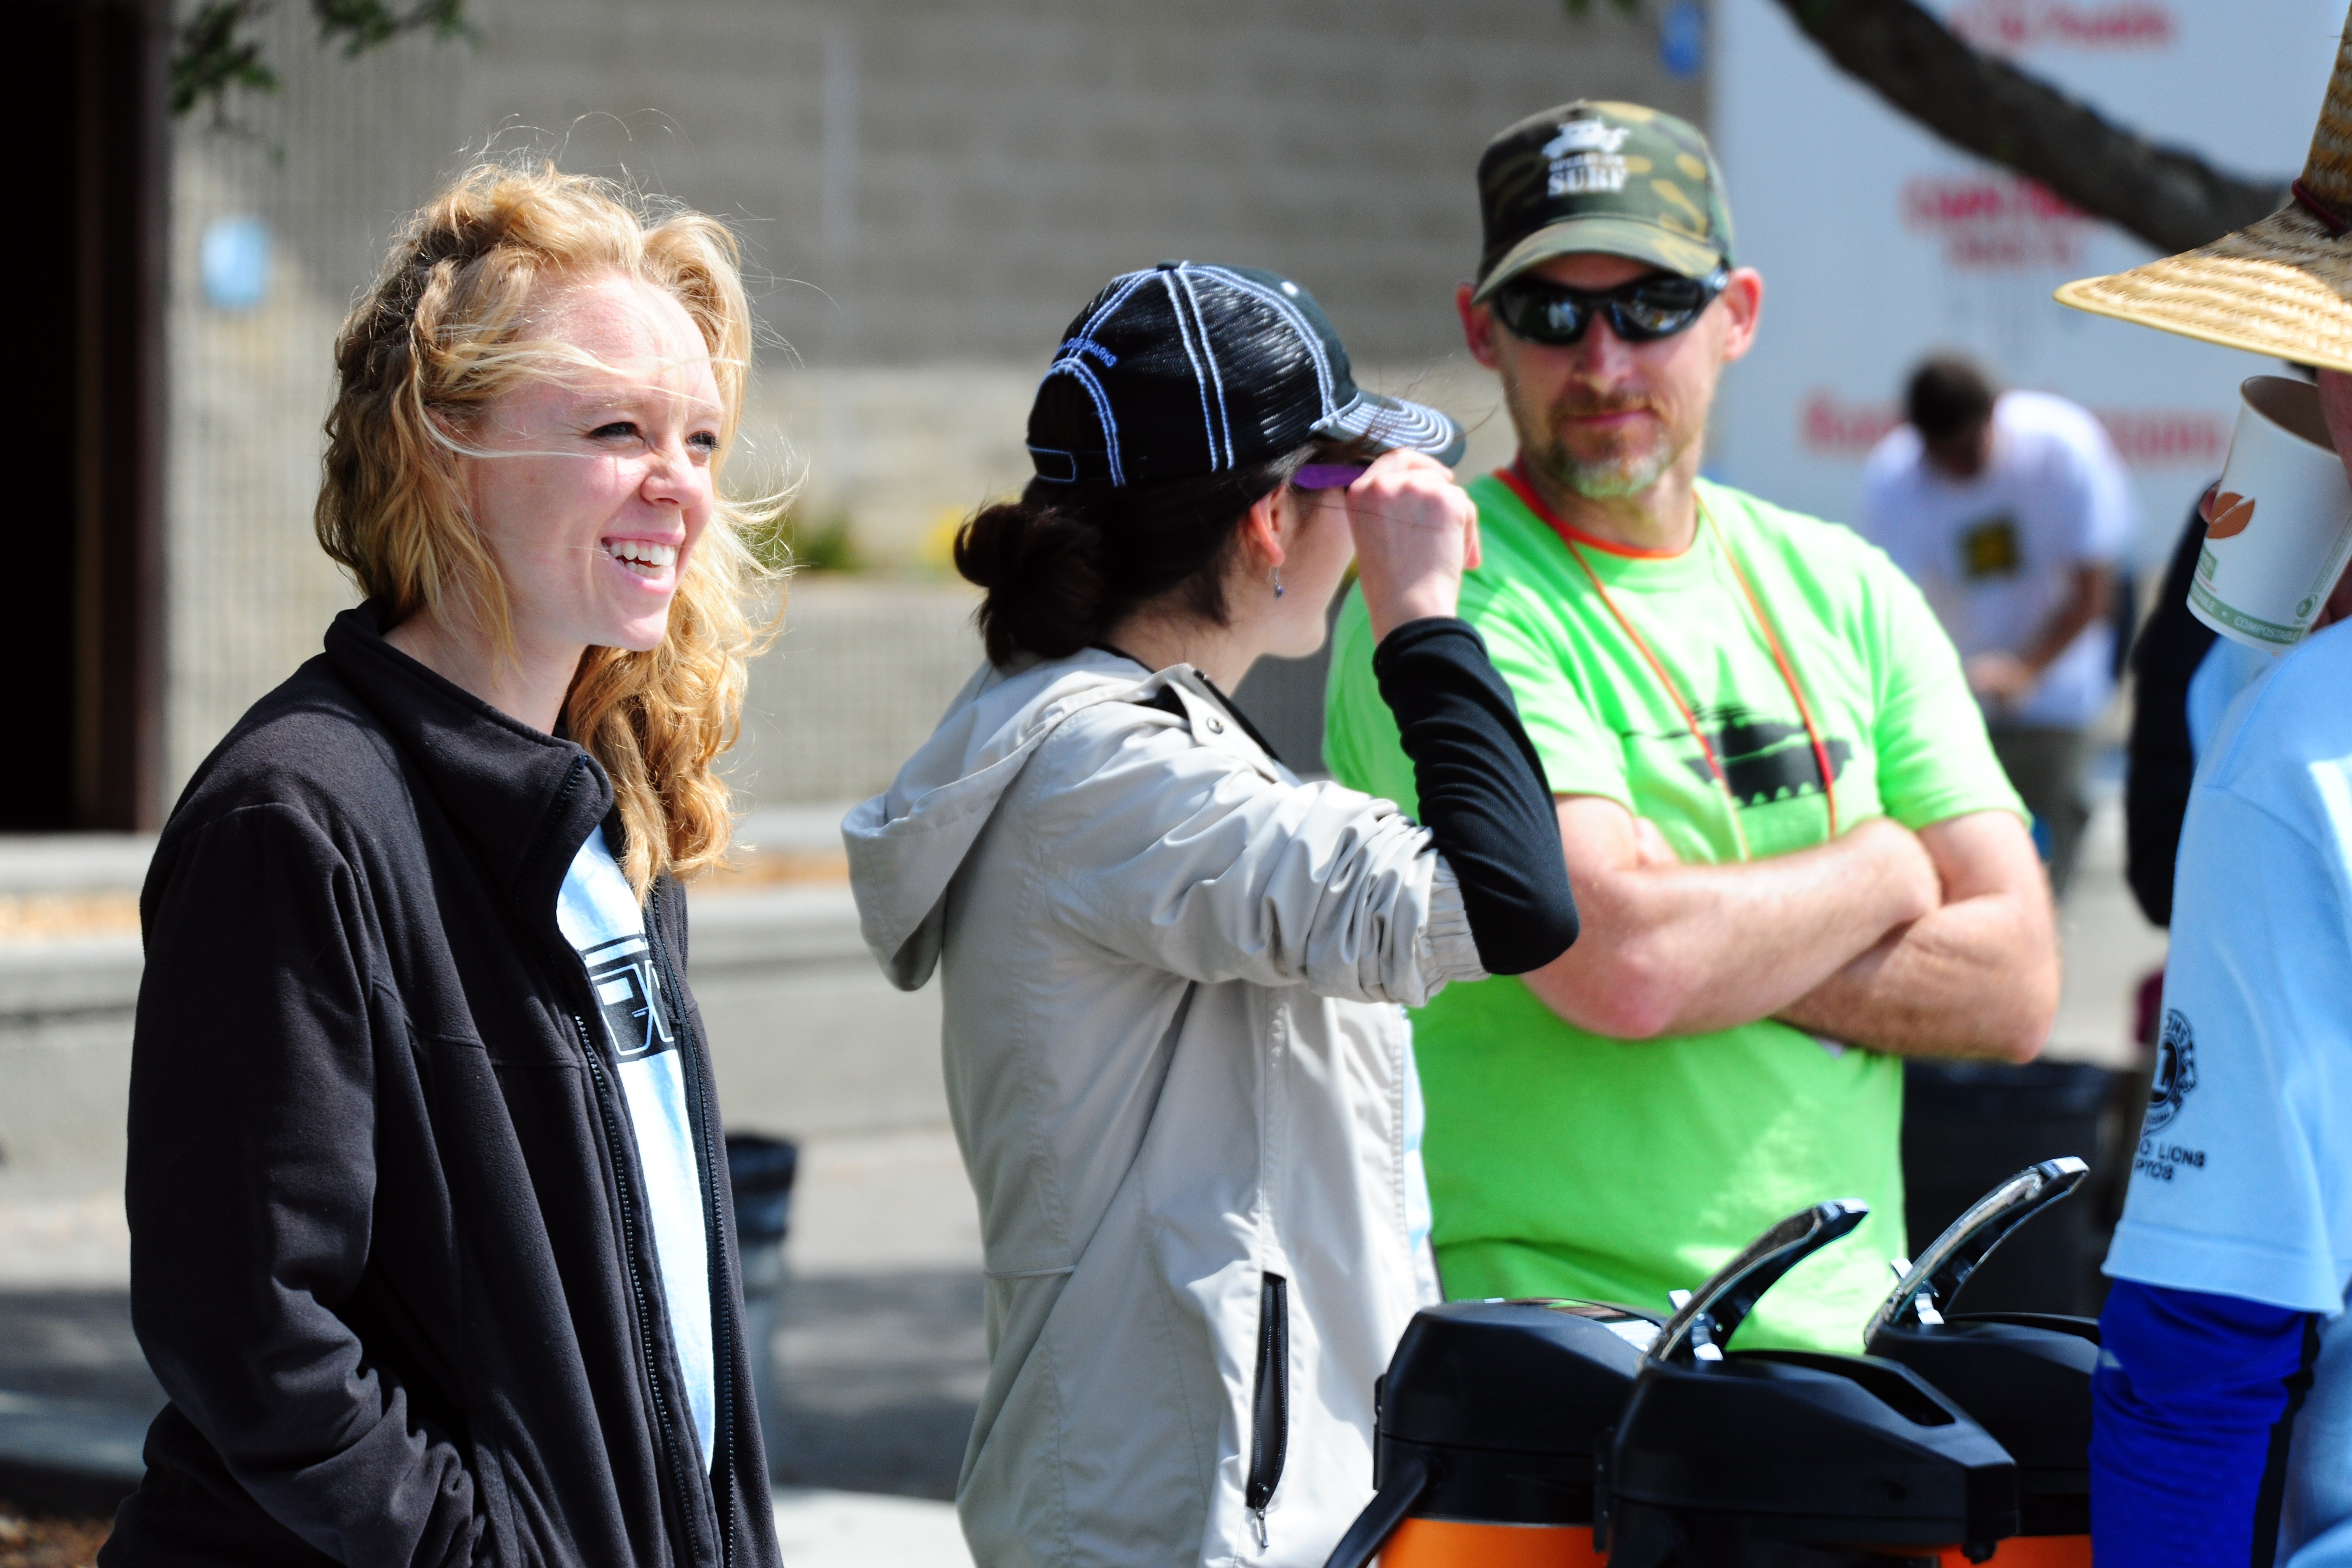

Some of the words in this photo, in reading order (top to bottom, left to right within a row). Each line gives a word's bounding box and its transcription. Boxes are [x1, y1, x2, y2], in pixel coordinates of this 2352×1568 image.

[1548, 167, 1628, 198] SURF
[1082, 339, 1118, 368] SHARKS
[2234, 616, 2300, 642] COMPOSTABLE
[2158, 1143, 2205, 1168] LIONS
